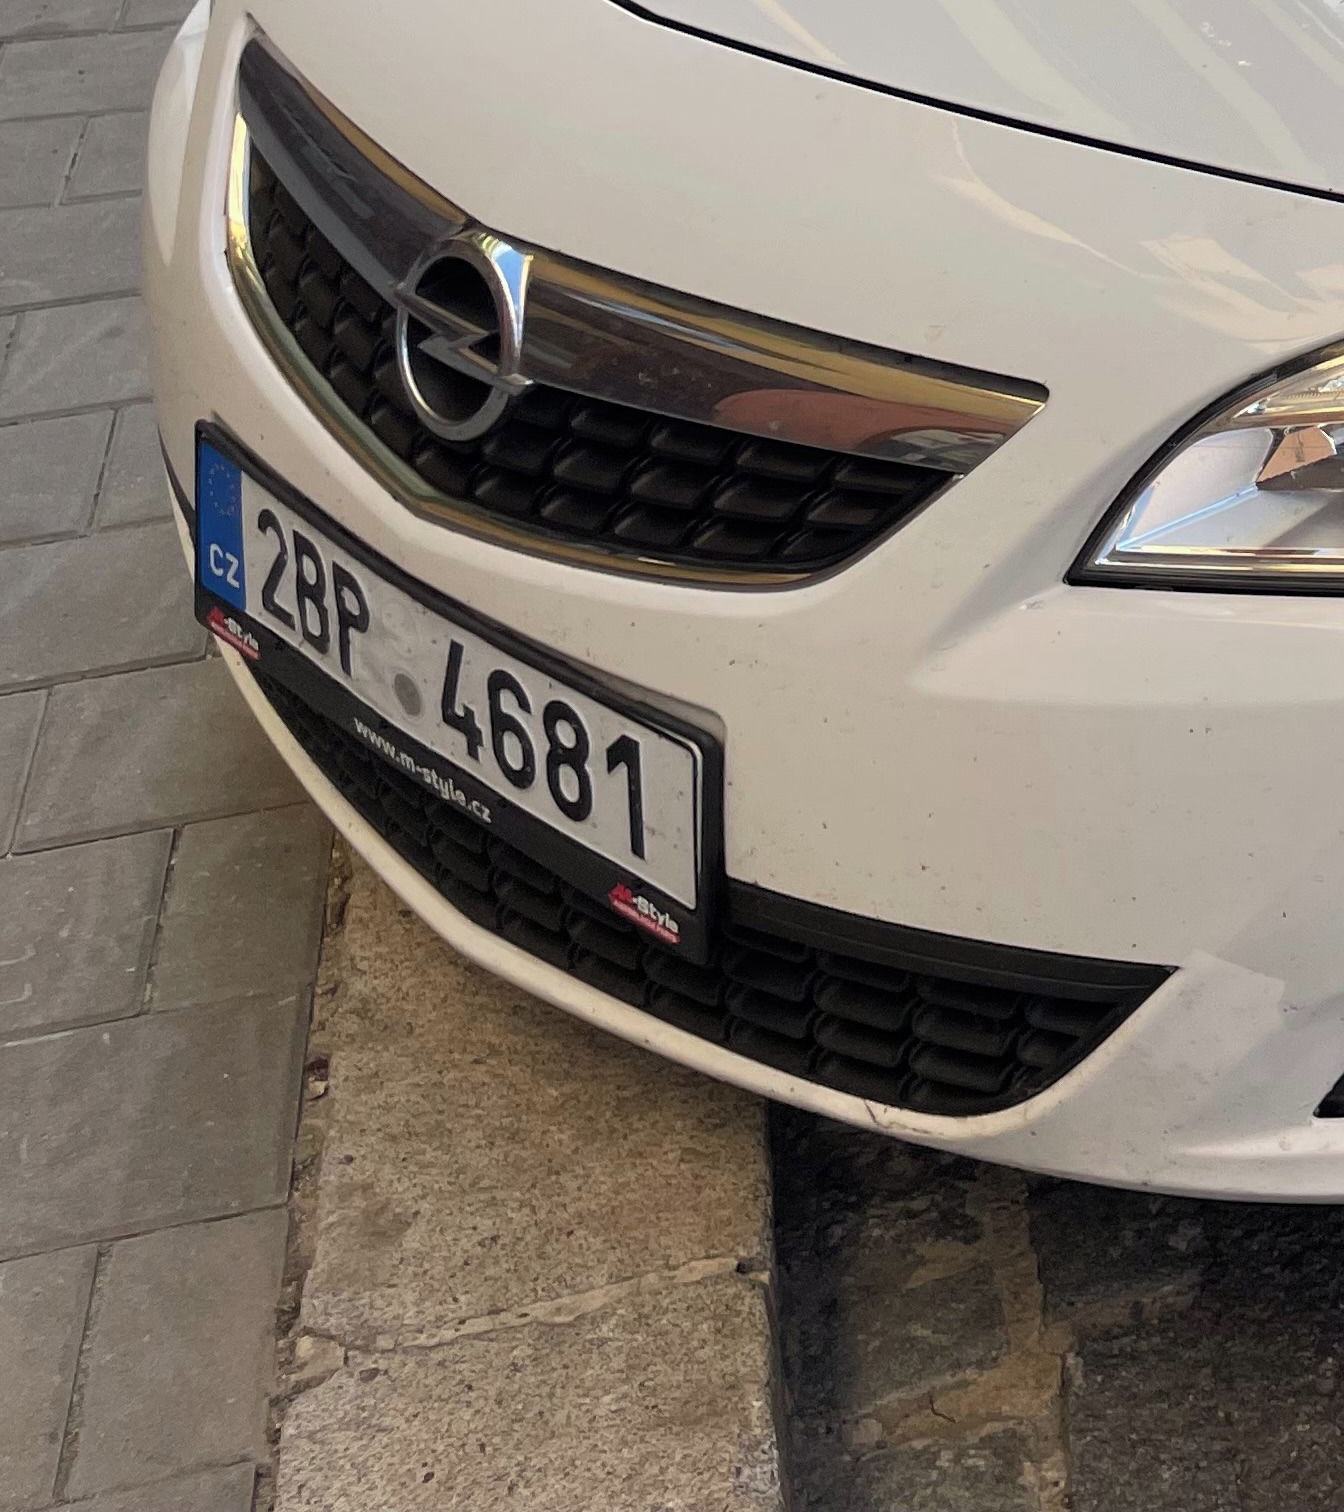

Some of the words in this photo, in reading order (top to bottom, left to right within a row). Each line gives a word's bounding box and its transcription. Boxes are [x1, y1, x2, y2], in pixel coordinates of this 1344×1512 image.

[209, 542, 240, 589] CZ
[257, 508, 371, 677] 2BP
[440, 640, 648, 861] 4681
[353, 717, 493, 825] www.m-style.cz
